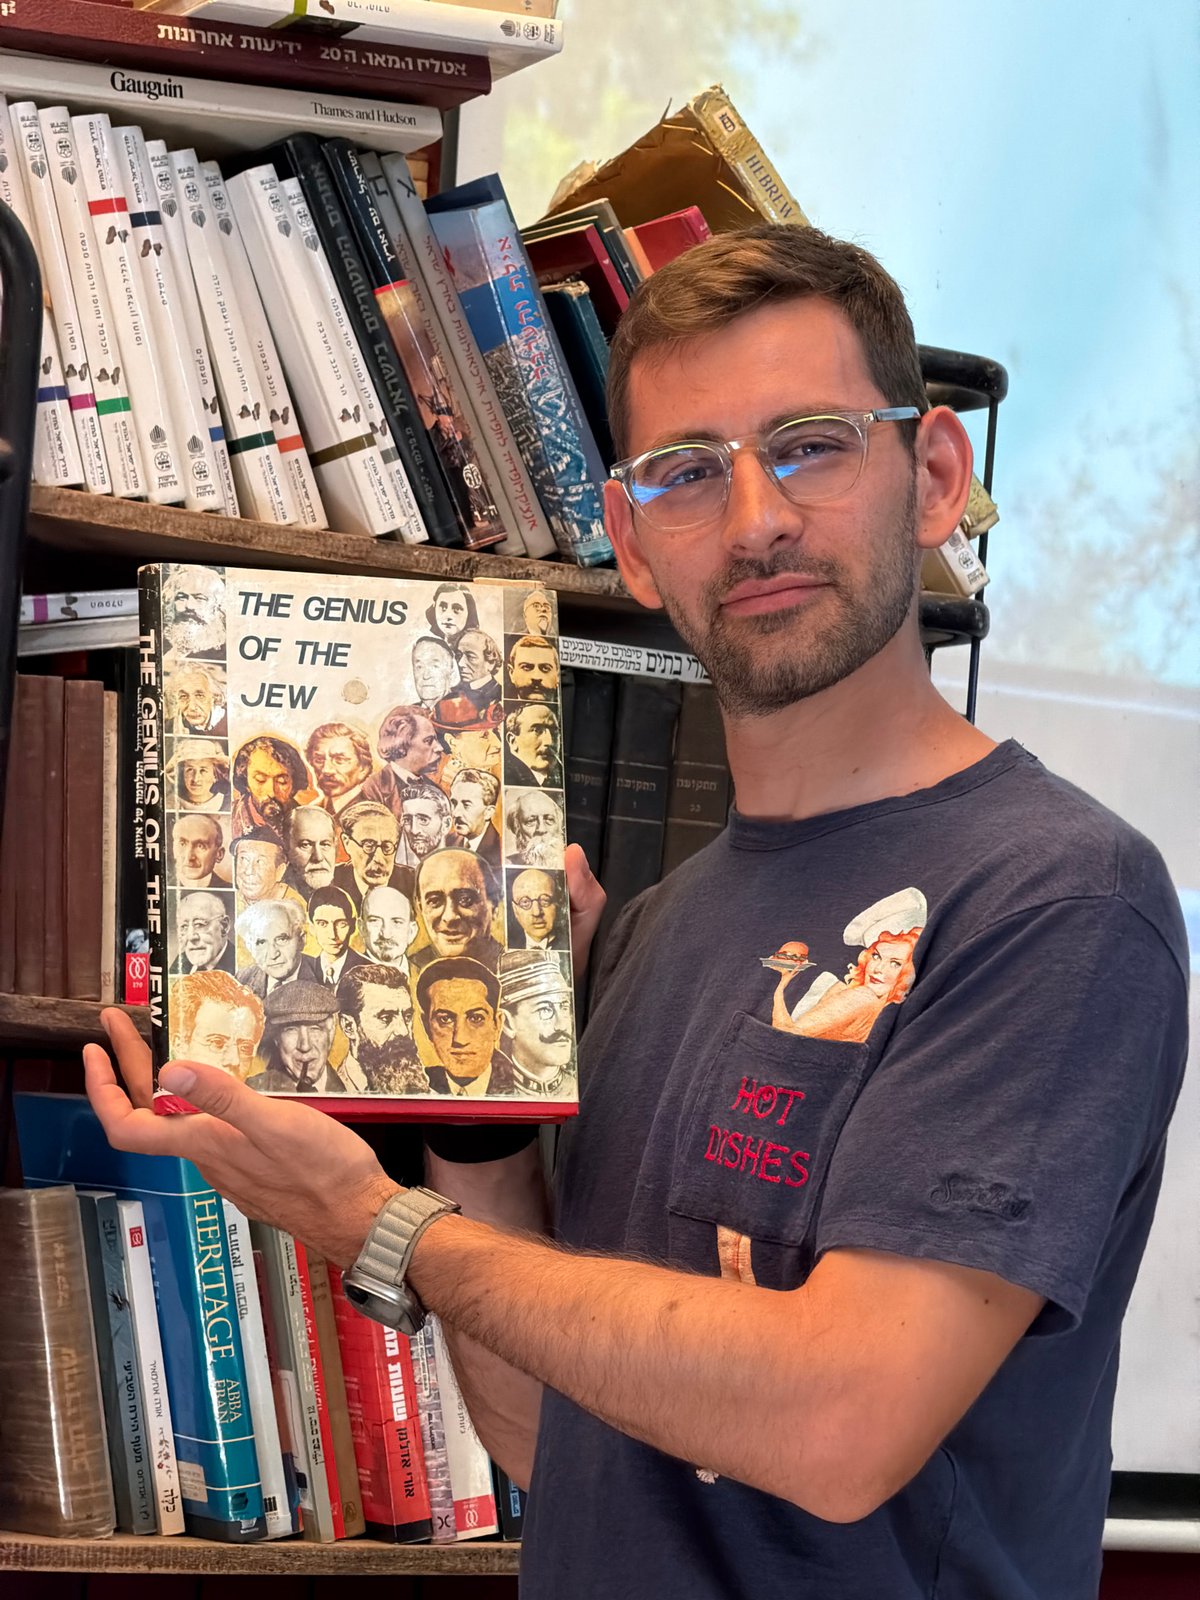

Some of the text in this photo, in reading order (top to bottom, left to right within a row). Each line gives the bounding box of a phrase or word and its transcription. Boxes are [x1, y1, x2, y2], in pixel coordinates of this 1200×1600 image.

[155, 24, 301, 55] ידיעות אחרונות
[108, 70, 184, 99] Gauguin
[309, 101, 416, 125] Thames and Hudson
[345, 148, 368, 194] ישראל
[744, 154, 793, 219] HEBREW
[366, 205, 382, 226] עם
[373, 227, 396, 262] וארץ
[420, 235, 445, 276] ישראל
[495, 234, 525, 293] אילת
[118, 256, 130, 284] הגליל
[125, 287, 139, 317] העליון
[310, 160, 408, 416] אתרים היסטוריים בישראל
[435, 277, 459, 314] בארץ
[63, 322, 77, 350] השרון
[97, 323, 109, 355] הכרמל
[195, 346, 210, 385] העמקים
[257, 340, 278, 397] הנגב הצפוני
[316, 320, 348, 396] הר הנגב והערבה
[448, 317, 489, 396] ארכיאולוגיות
[360, 385, 376, 409] מילון
[479, 398, 509, 448] לחפירות
[501, 449, 540, 531] אנציקלופדיה
[90, 598, 123, 609] השפלה
[238, 590, 408, 625] THE GENIUS
[239, 636, 351, 667] OF THE
[561, 639, 642, 659] סיפורם של שבעים
[602, 656, 641, 671] בתולדות
[645, 651, 685, 675] בתים
[241, 682, 318, 710] JEW
[133, 760, 144, 857] המלחמה של איוואן
[140, 630, 163, 1027] THE GENIUS OF THE JEW
[730, 1076, 805, 1126] HOT
[704, 1125, 810, 1188] DISHES
[192, 1196, 234, 1360] HERITAGE
[234, 1282, 248, 1319] שיבומי
[154, 1398, 163, 1417] אורה
[213, 1379, 230, 1425] EBAN
[224, 1378, 243, 1423] ABBA
[306, 1405, 315, 1414] 12
[388, 1361, 407, 1421] שעות
[123, 1360, 144, 1464] מעוף הירח השביעי
[395, 1427, 414, 1468] אדלמן
[401, 1472, 416, 1498] אורי
